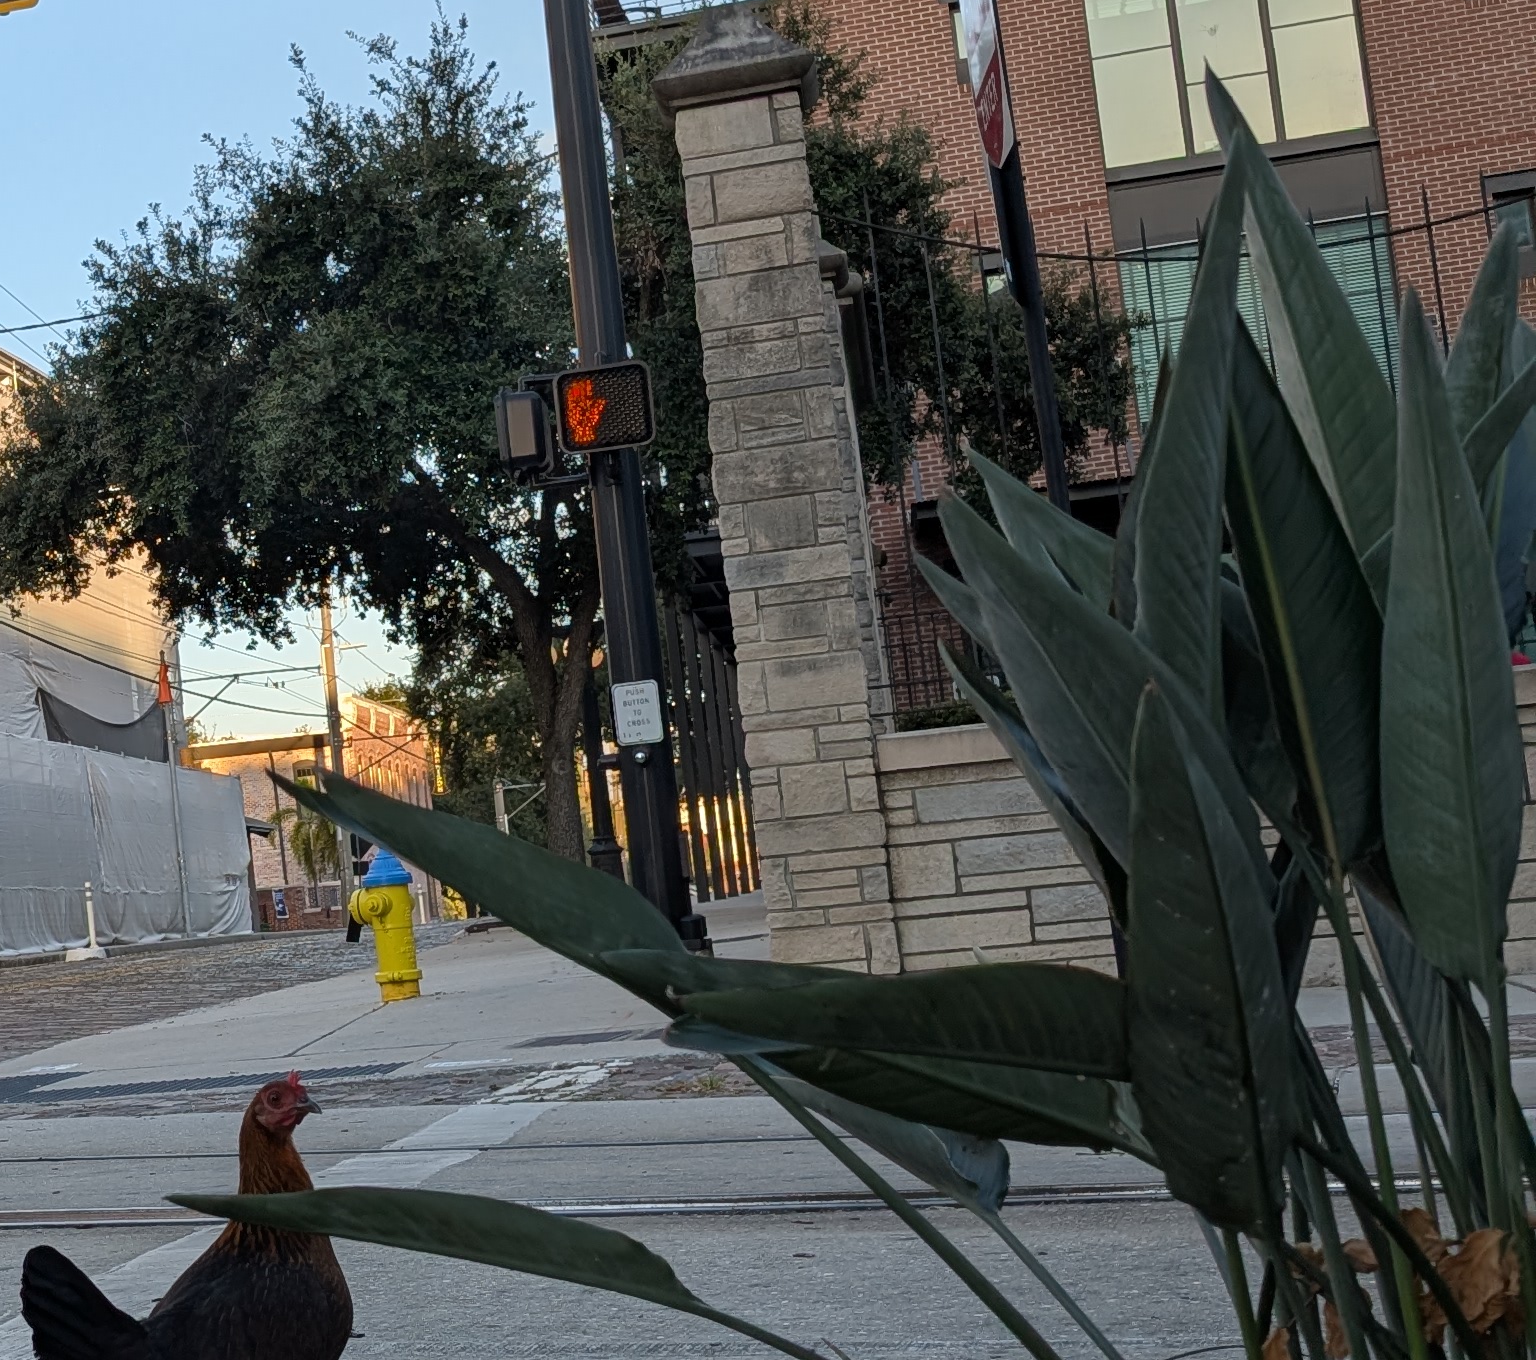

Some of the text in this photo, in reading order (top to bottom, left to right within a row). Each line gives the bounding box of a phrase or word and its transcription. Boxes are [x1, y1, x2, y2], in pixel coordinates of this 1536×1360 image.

[980, 71, 999, 131] ENTER
[625, 688, 645, 696] PUSH
[622, 697, 650, 707] BUTTON
[627, 718, 651, 727] CROSS
